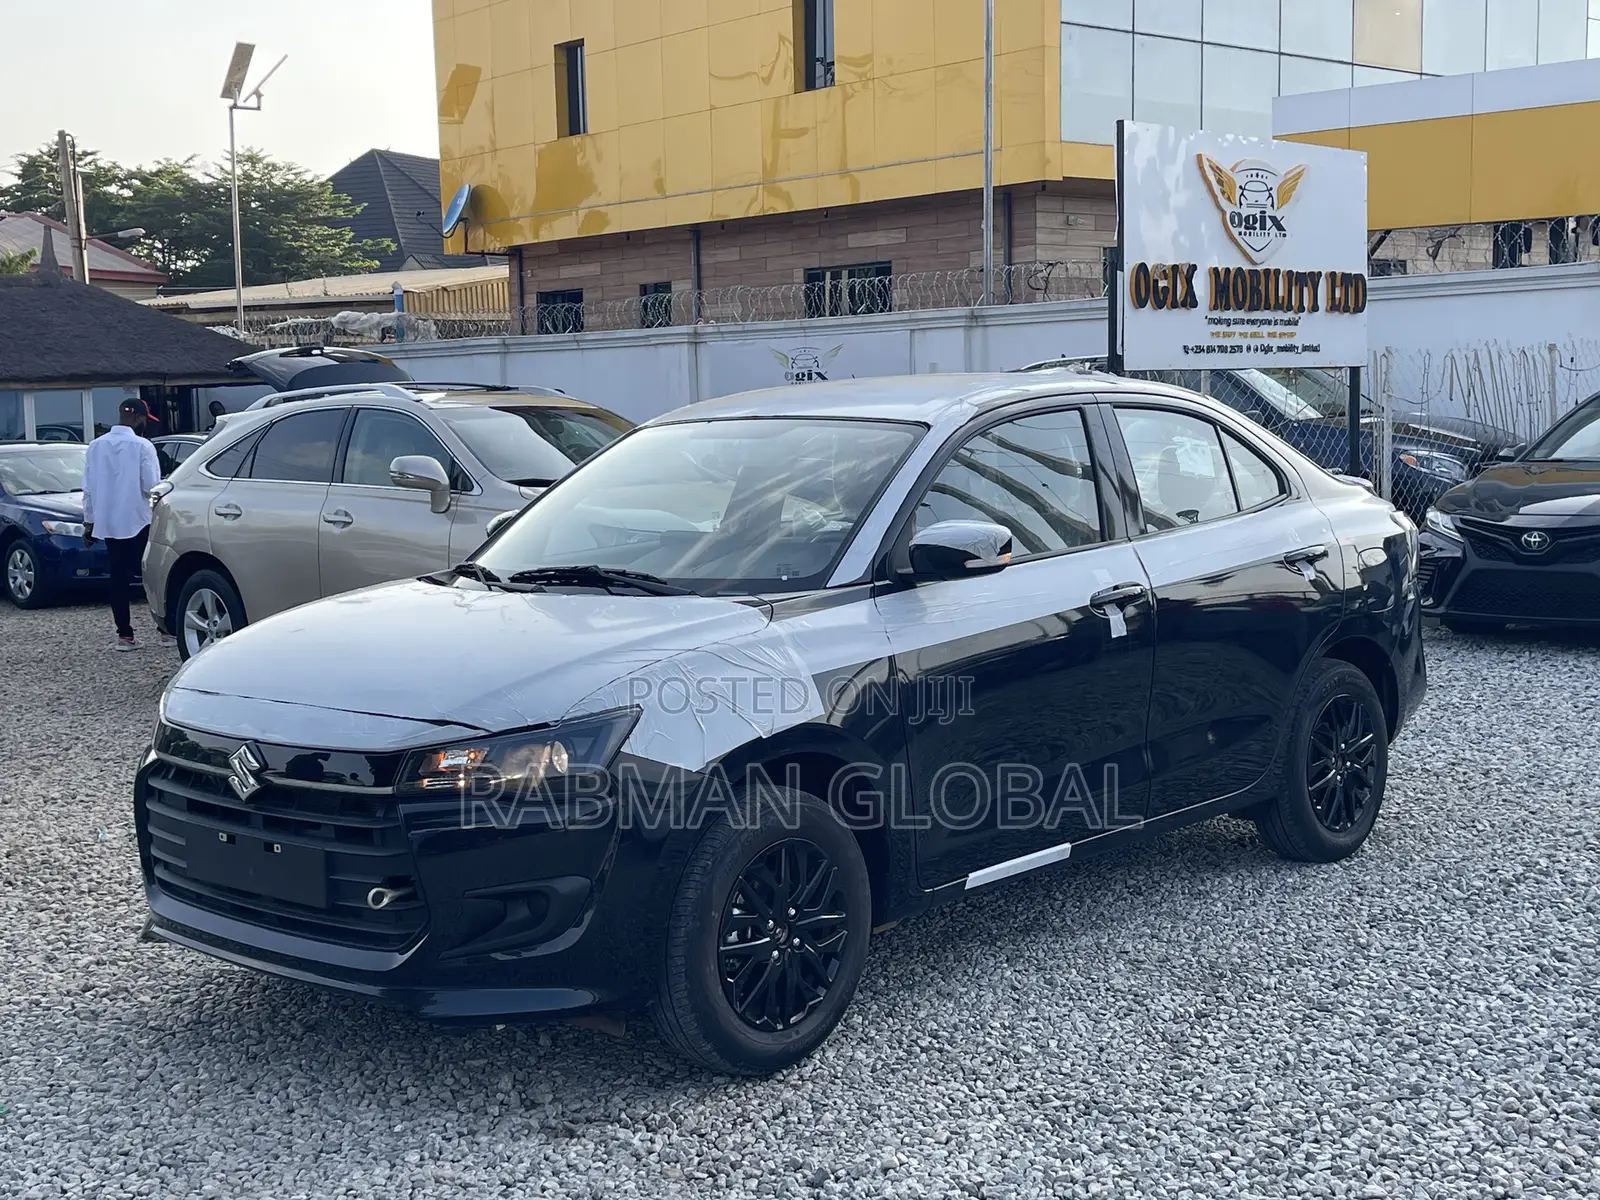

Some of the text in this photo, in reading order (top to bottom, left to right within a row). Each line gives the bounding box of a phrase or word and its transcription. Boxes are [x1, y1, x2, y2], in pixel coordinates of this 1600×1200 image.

[1229, 210, 1287, 231] Ogix
[1130, 262, 1368, 315] OGIX MOBILITY LTD
[1232, 317, 1245, 326] sure
[1246, 318, 1273, 328] everyone
[1273, 316, 1279, 326] is
